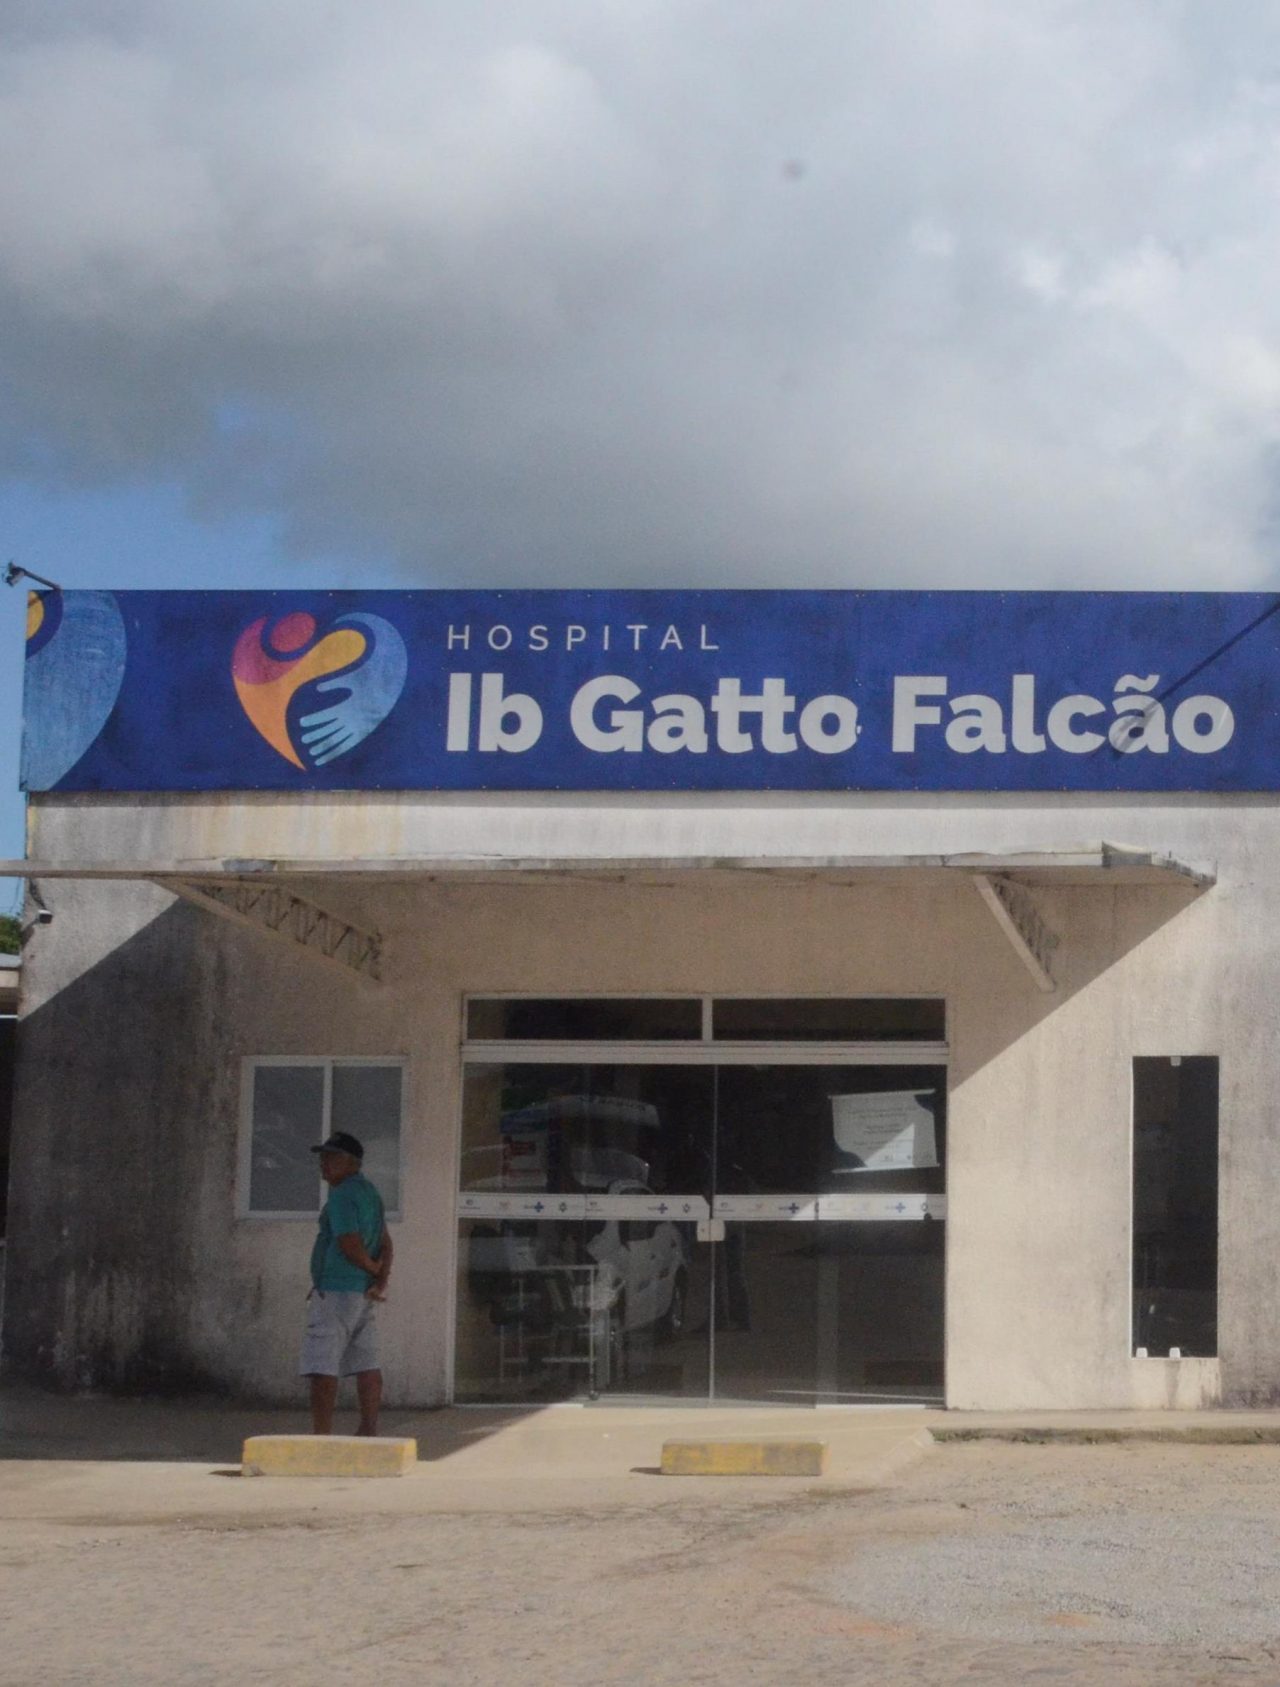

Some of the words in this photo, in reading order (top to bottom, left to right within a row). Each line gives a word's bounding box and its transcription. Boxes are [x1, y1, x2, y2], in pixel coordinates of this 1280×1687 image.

[448, 624, 719, 651] HOSPITAL
[446, 672, 543, 753] Ib
[570, 674, 858, 754] Gatto
[891, 673, 1235, 754] Falcão
